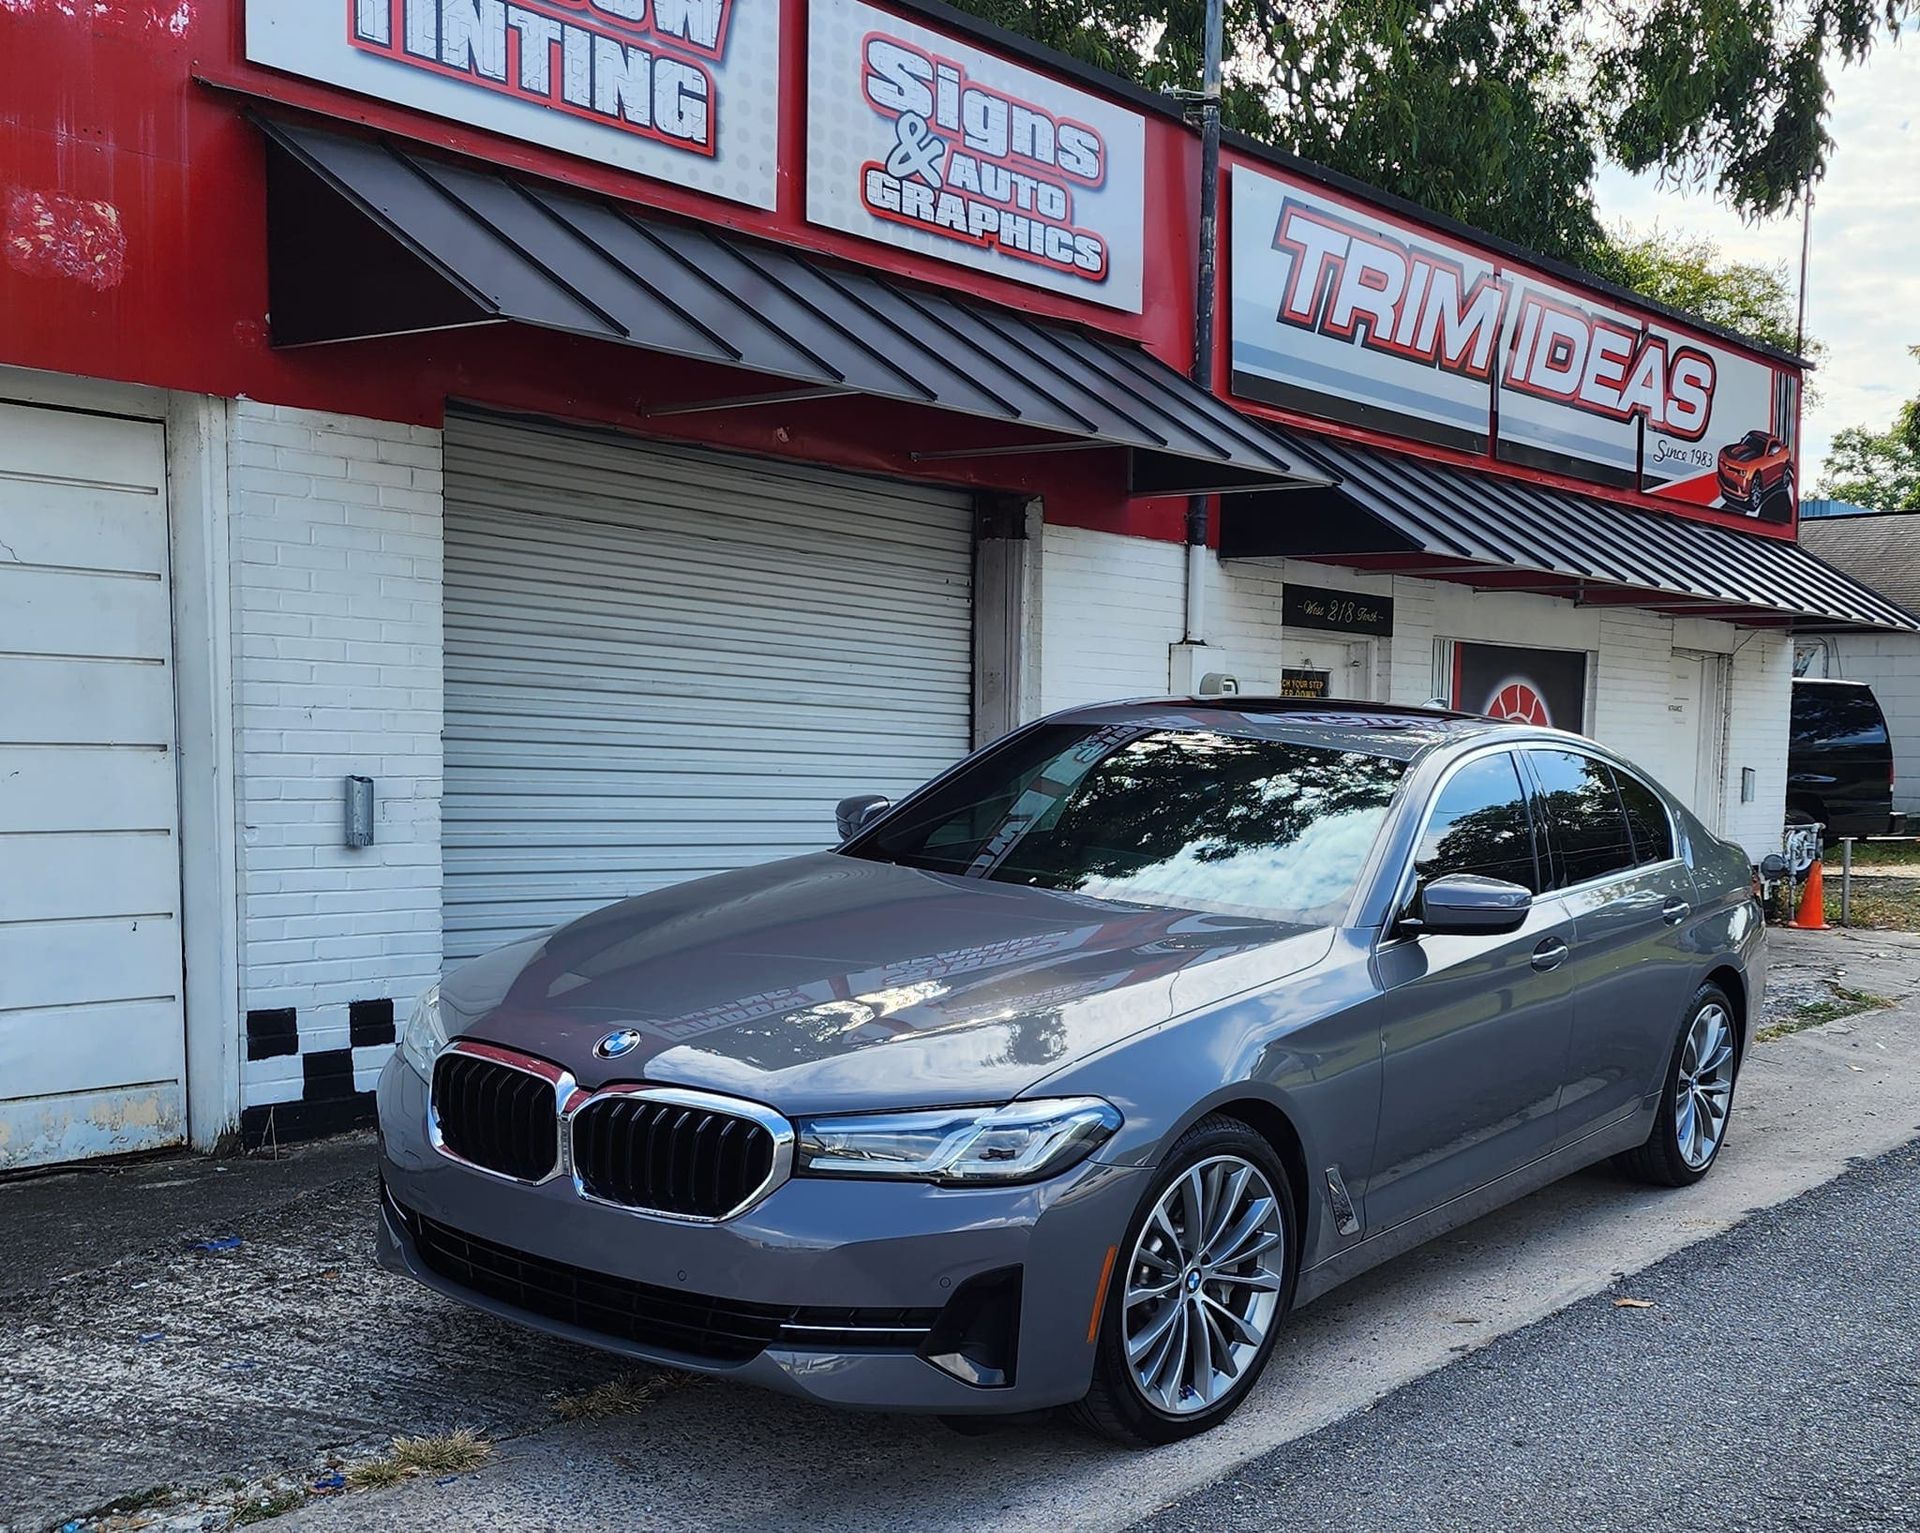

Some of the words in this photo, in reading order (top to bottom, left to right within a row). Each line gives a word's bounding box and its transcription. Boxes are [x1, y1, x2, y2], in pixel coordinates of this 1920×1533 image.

[864, 36, 1102, 182] Signs
[885, 109, 946, 189] &
[946, 149, 1069, 222] AUTO
[864, 168, 1104, 274] GRAPHICS
[1278, 203, 1503, 377] TRIM
[1505, 297, 1715, 439] IDEAS
[1653, 439, 1688, 462] Since
[1690, 448, 1713, 468] 1983
[1327, 599, 1356, 624] 218
